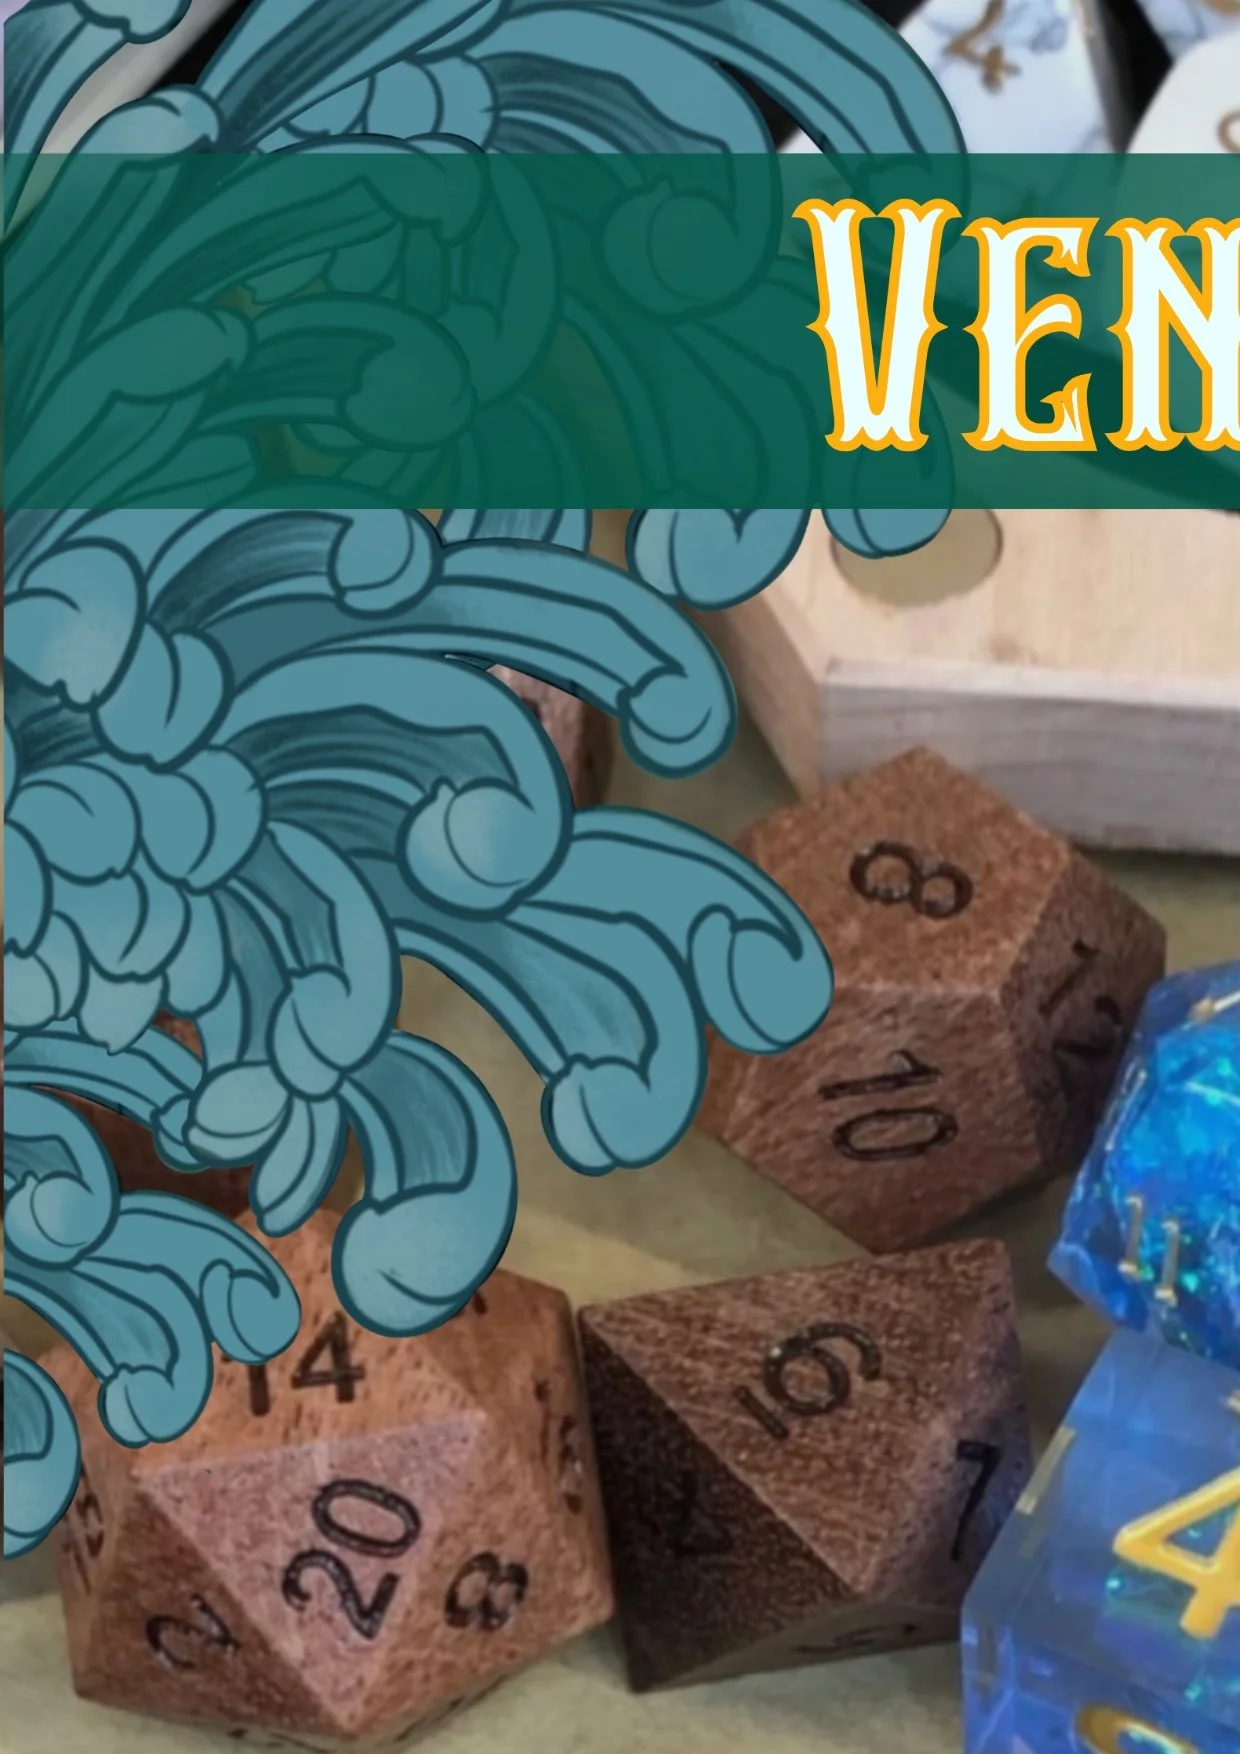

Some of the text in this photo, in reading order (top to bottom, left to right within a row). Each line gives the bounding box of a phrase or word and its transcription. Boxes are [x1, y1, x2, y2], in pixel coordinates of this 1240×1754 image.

[849, 841, 973, 919] 8
[819, 1049, 960, 1162] 10
[281, 1478, 421, 1641] 20
[956, 1439, 1001, 1562] 7
